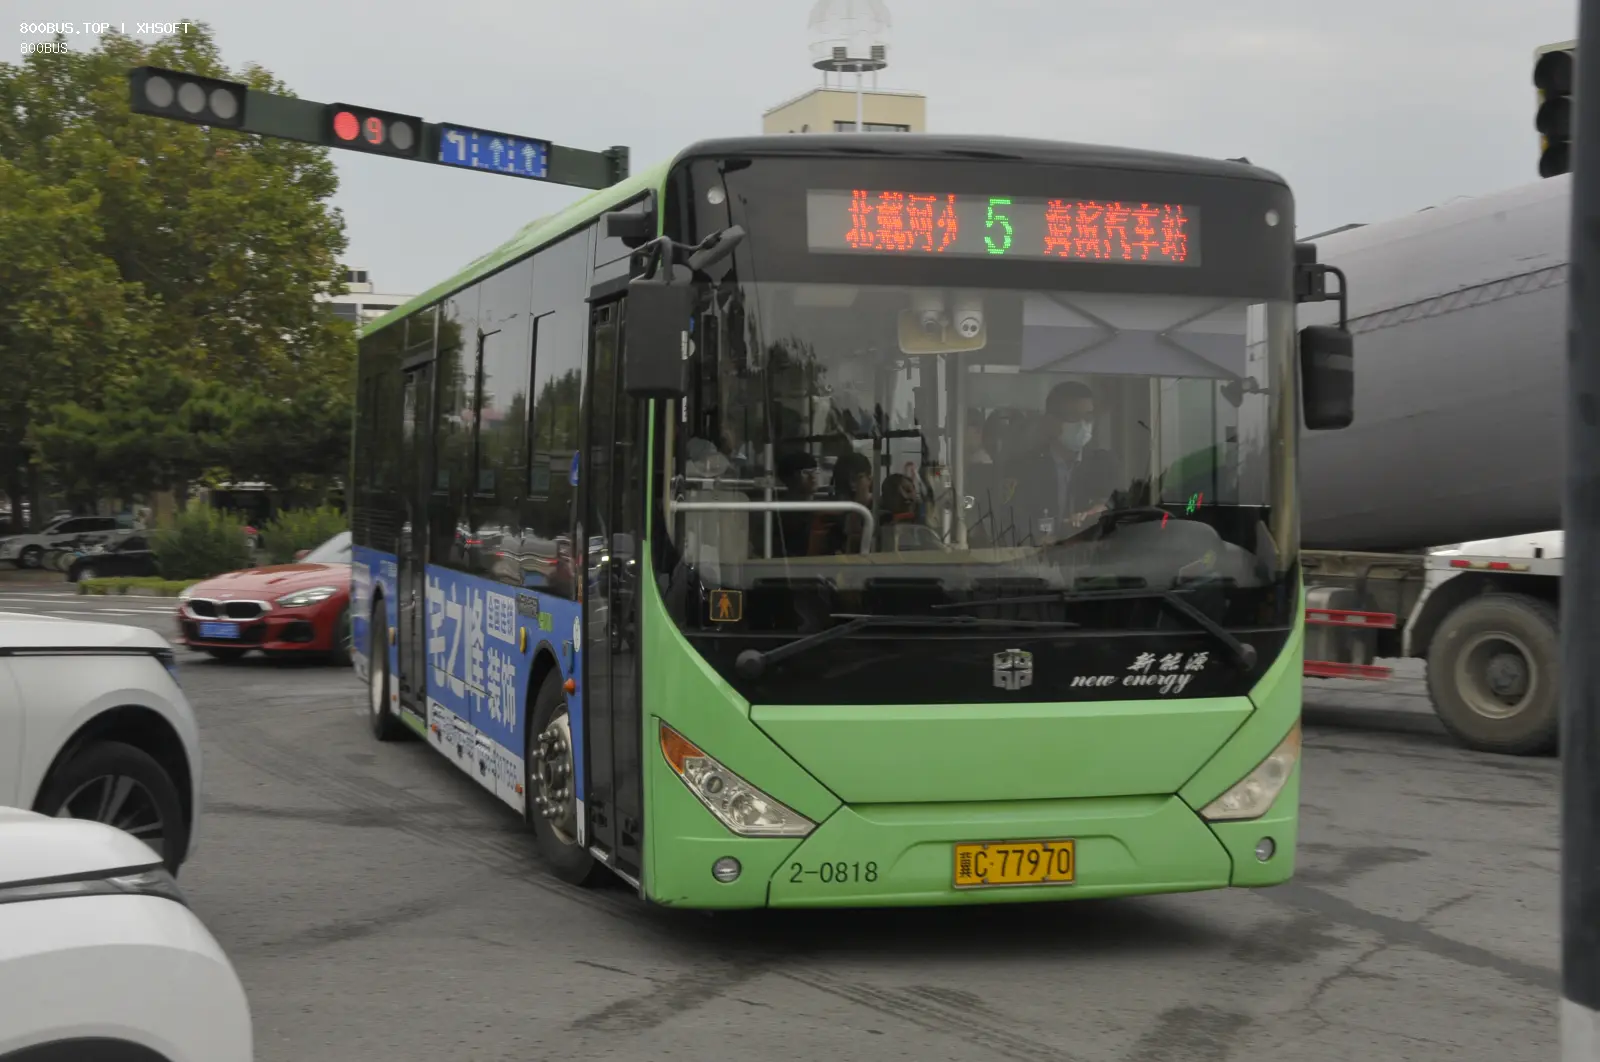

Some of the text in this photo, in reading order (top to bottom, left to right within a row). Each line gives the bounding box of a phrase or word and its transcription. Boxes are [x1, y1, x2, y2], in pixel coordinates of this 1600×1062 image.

[367, 117, 383, 144] 9
[984, 197, 1013, 255] 5
[1126, 651, 1210, 673] 新能源
[1070, 674, 1193, 694] new energy
[789, 862, 878, 883] 2-0818
